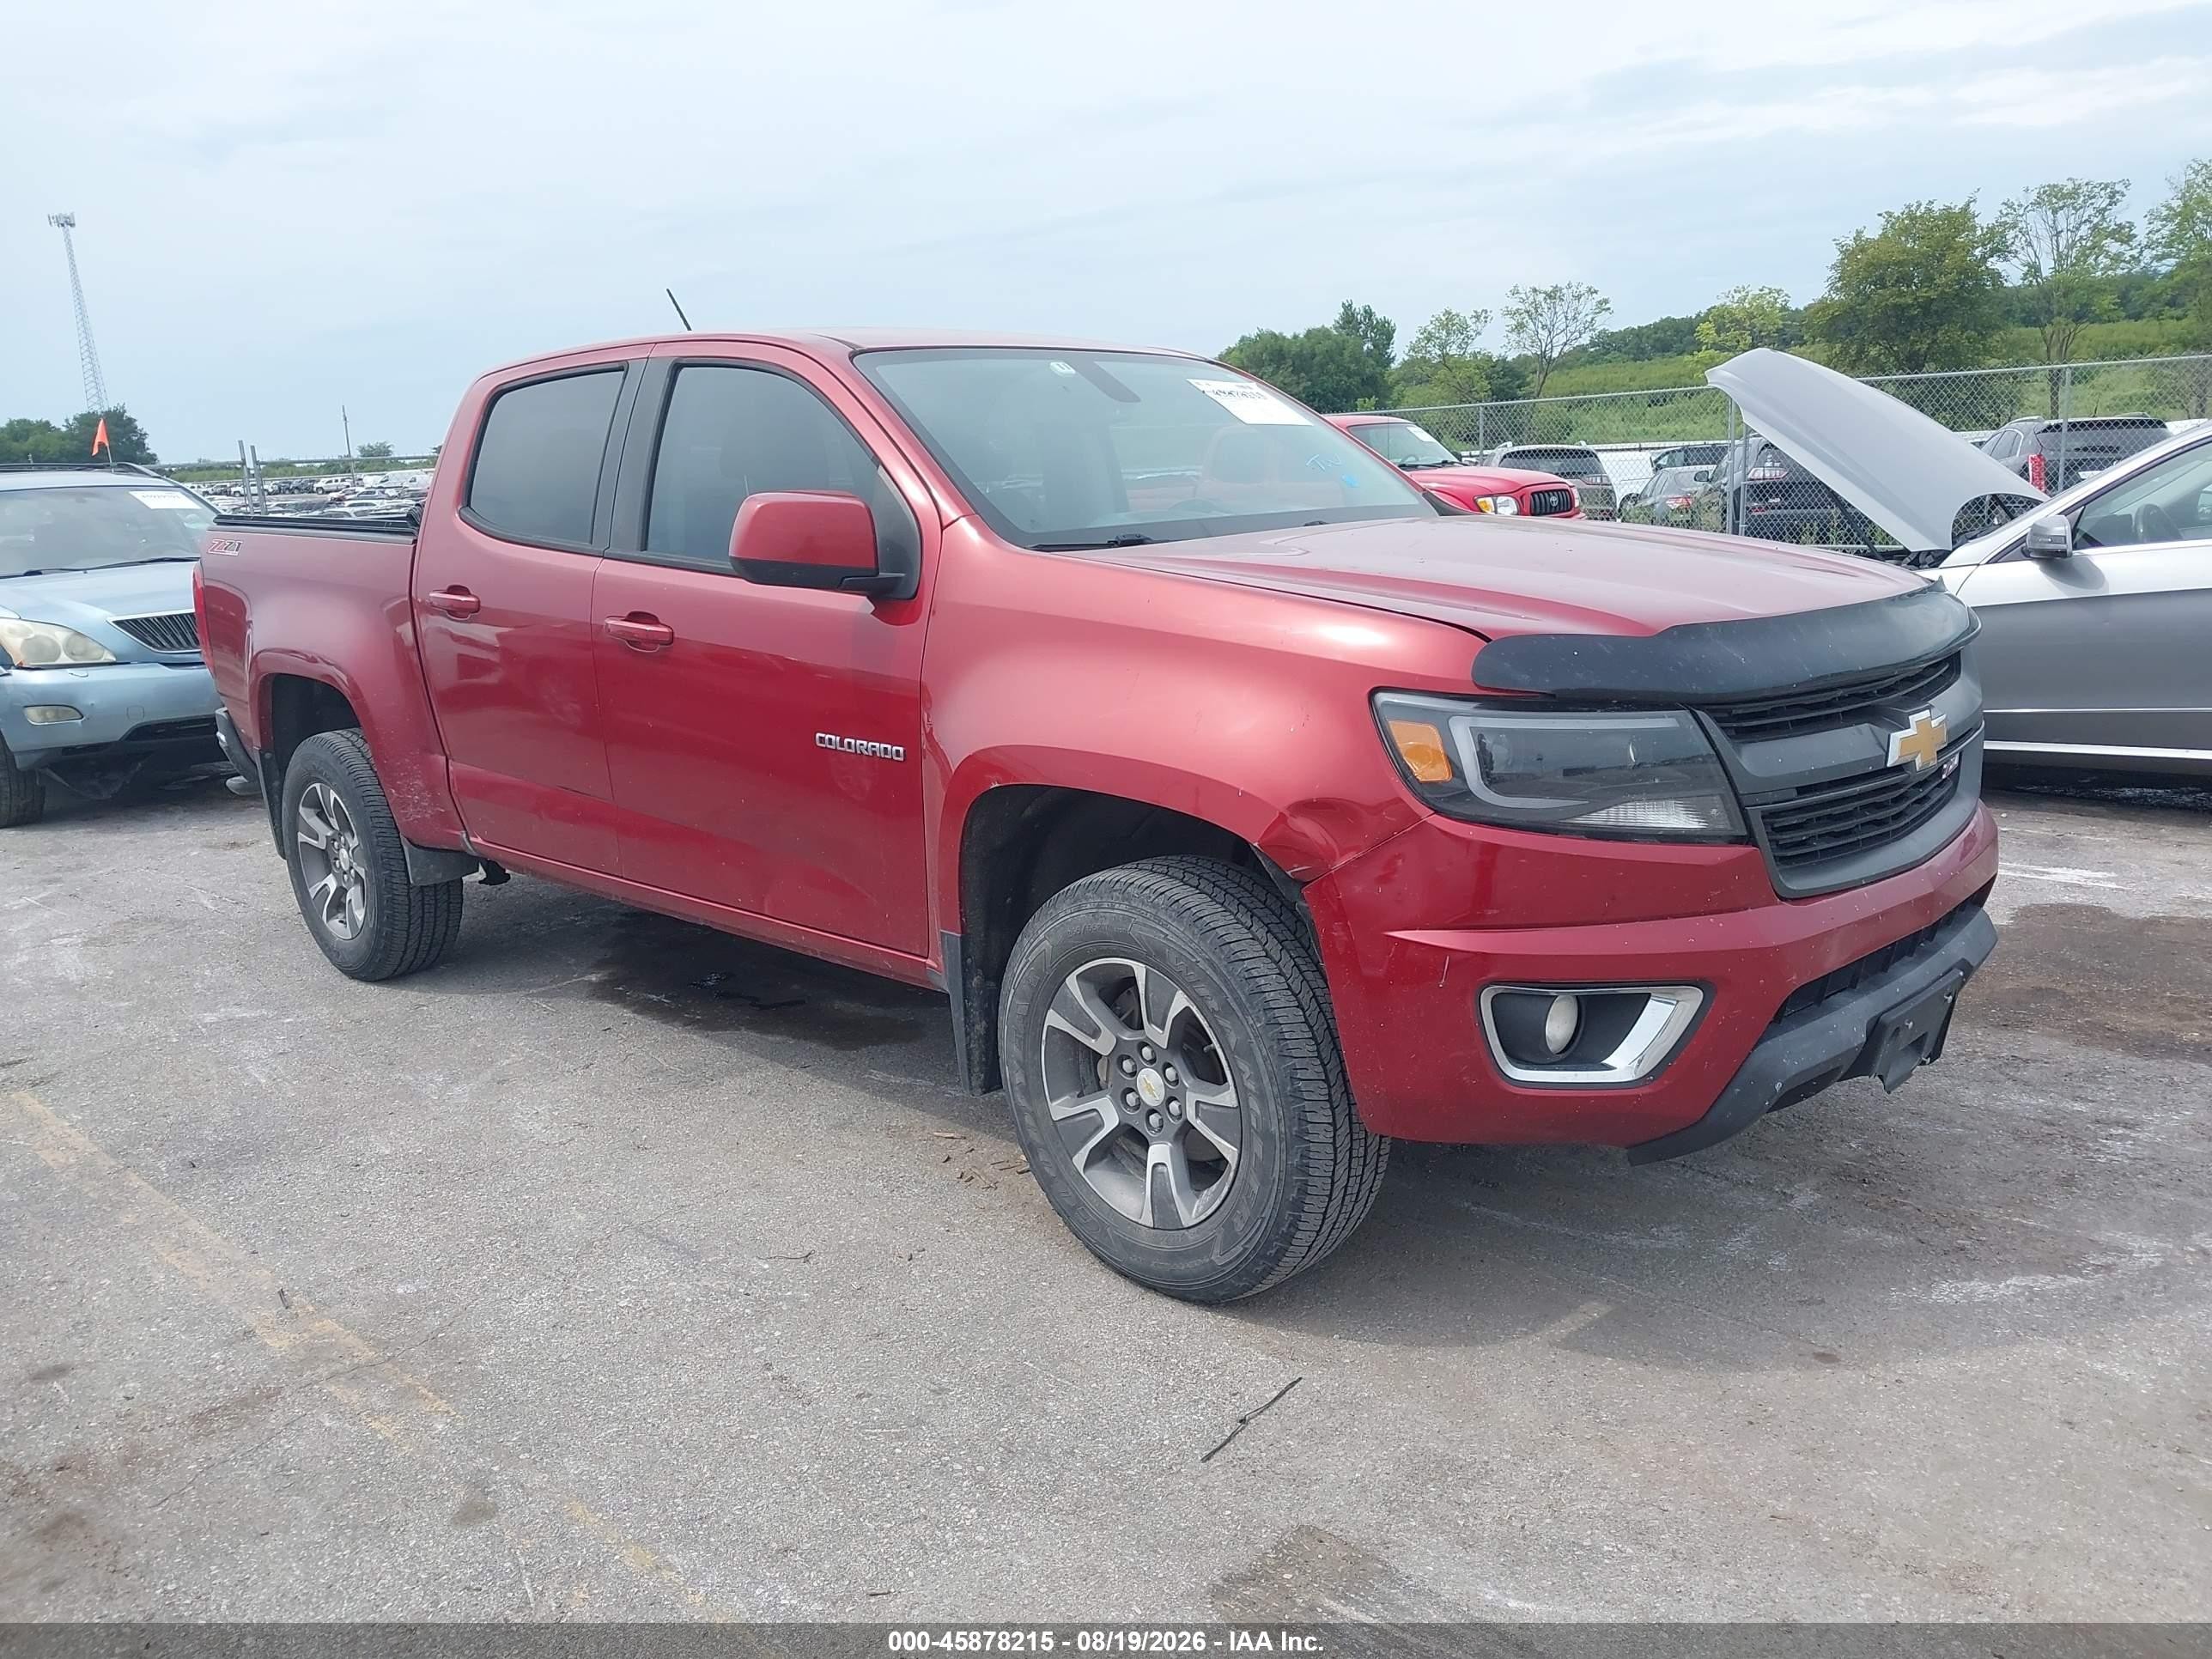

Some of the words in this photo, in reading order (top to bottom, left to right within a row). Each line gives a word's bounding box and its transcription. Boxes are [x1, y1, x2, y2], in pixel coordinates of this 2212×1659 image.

[208, 538, 243, 556] Z71
[815, 732, 905, 763] COLORADO
[1169, 951, 1267, 1235] WRANGLER
